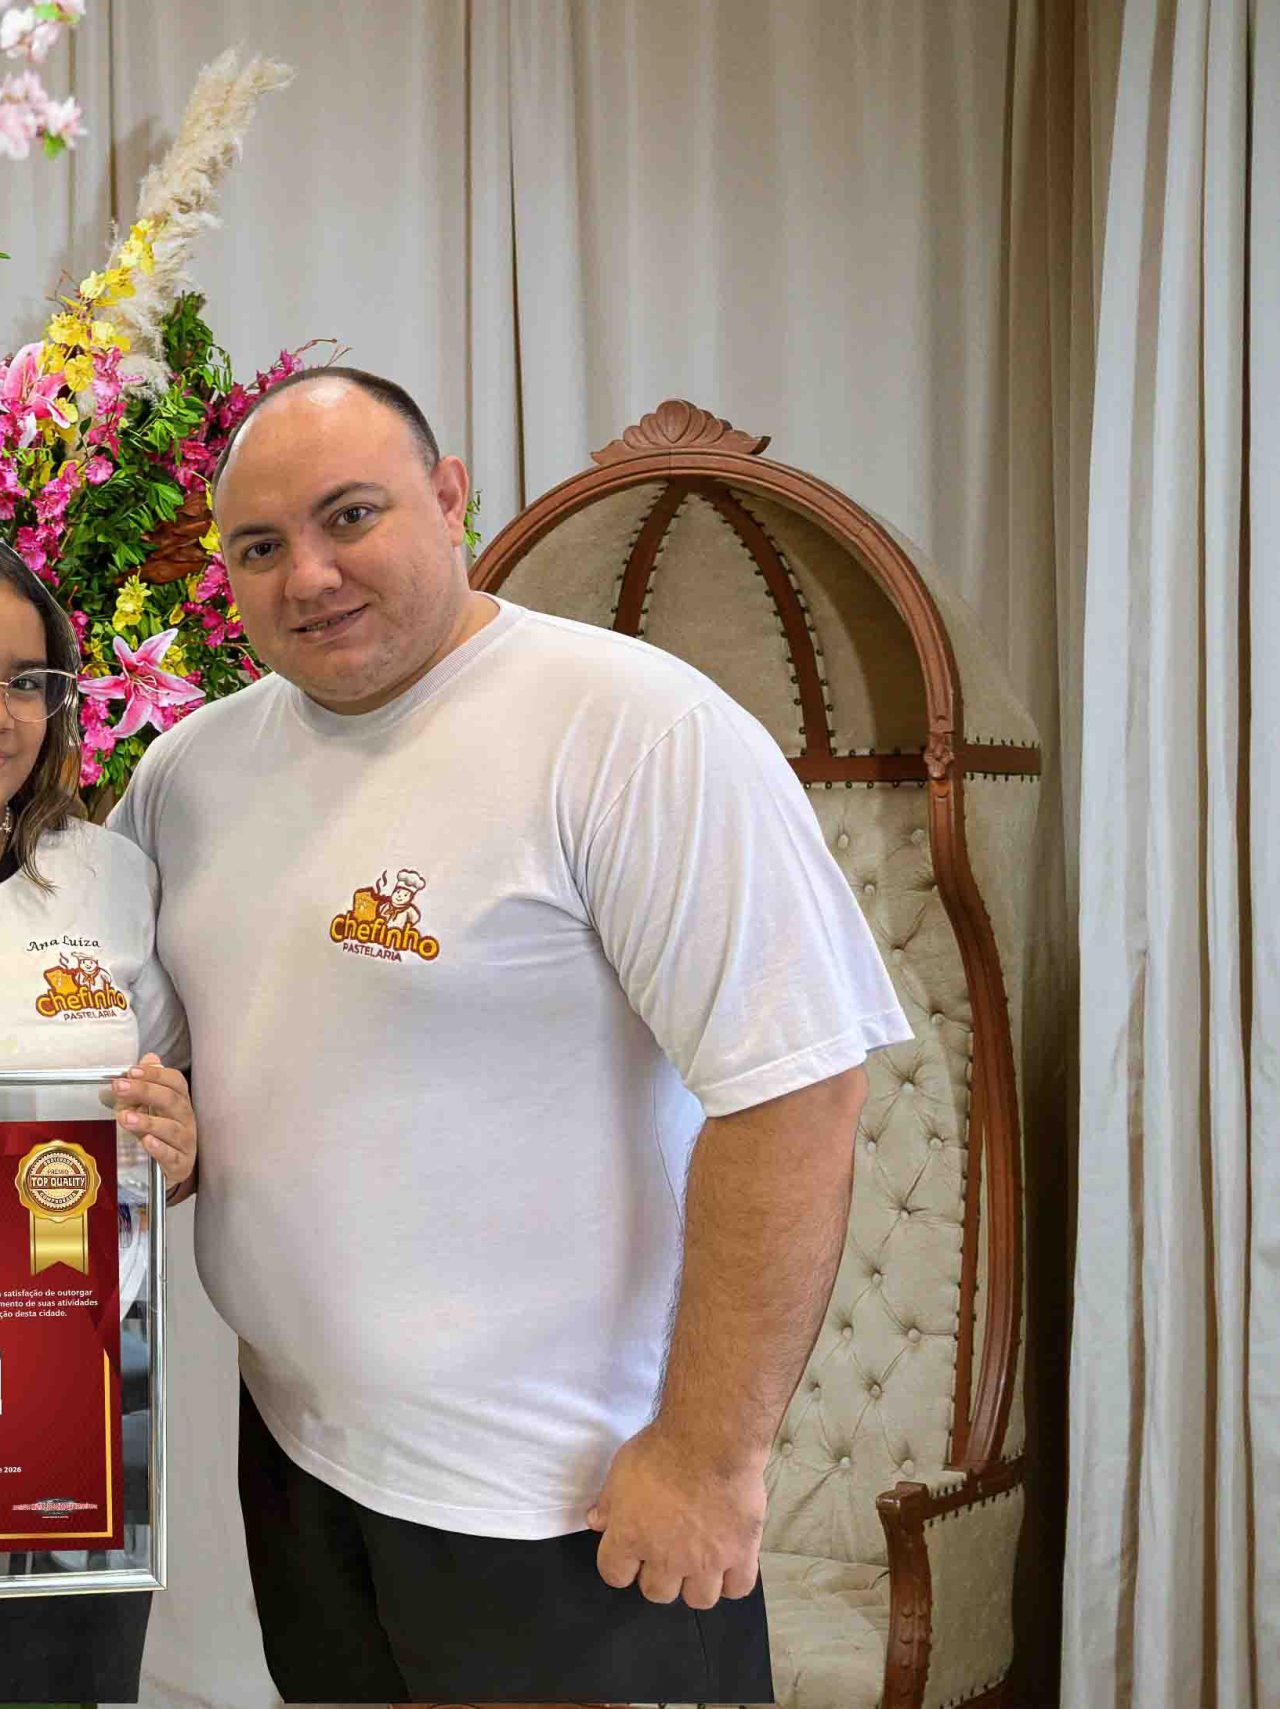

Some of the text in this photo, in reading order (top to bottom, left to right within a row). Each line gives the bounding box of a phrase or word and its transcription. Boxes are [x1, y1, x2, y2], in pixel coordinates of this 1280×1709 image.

[330, 911, 440, 961] Chefinho
[26, 935, 100, 952] Ana Luiza
[342, 942, 402, 962] PASTELARIA
[36, 983, 127, 1018] Chefinho
[63, 1009, 118, 1021] PASTELARIA
[31, 1176, 85, 1187] TOP QUALITY
[3, 1289, 43, 1299] satisfação
[44, 1289, 56, 1297] de
[57, 1289, 93, 1297] outorgar
[57, 1299, 99, 1307] atividades
[38, 1309, 67, 1317] cidade.
